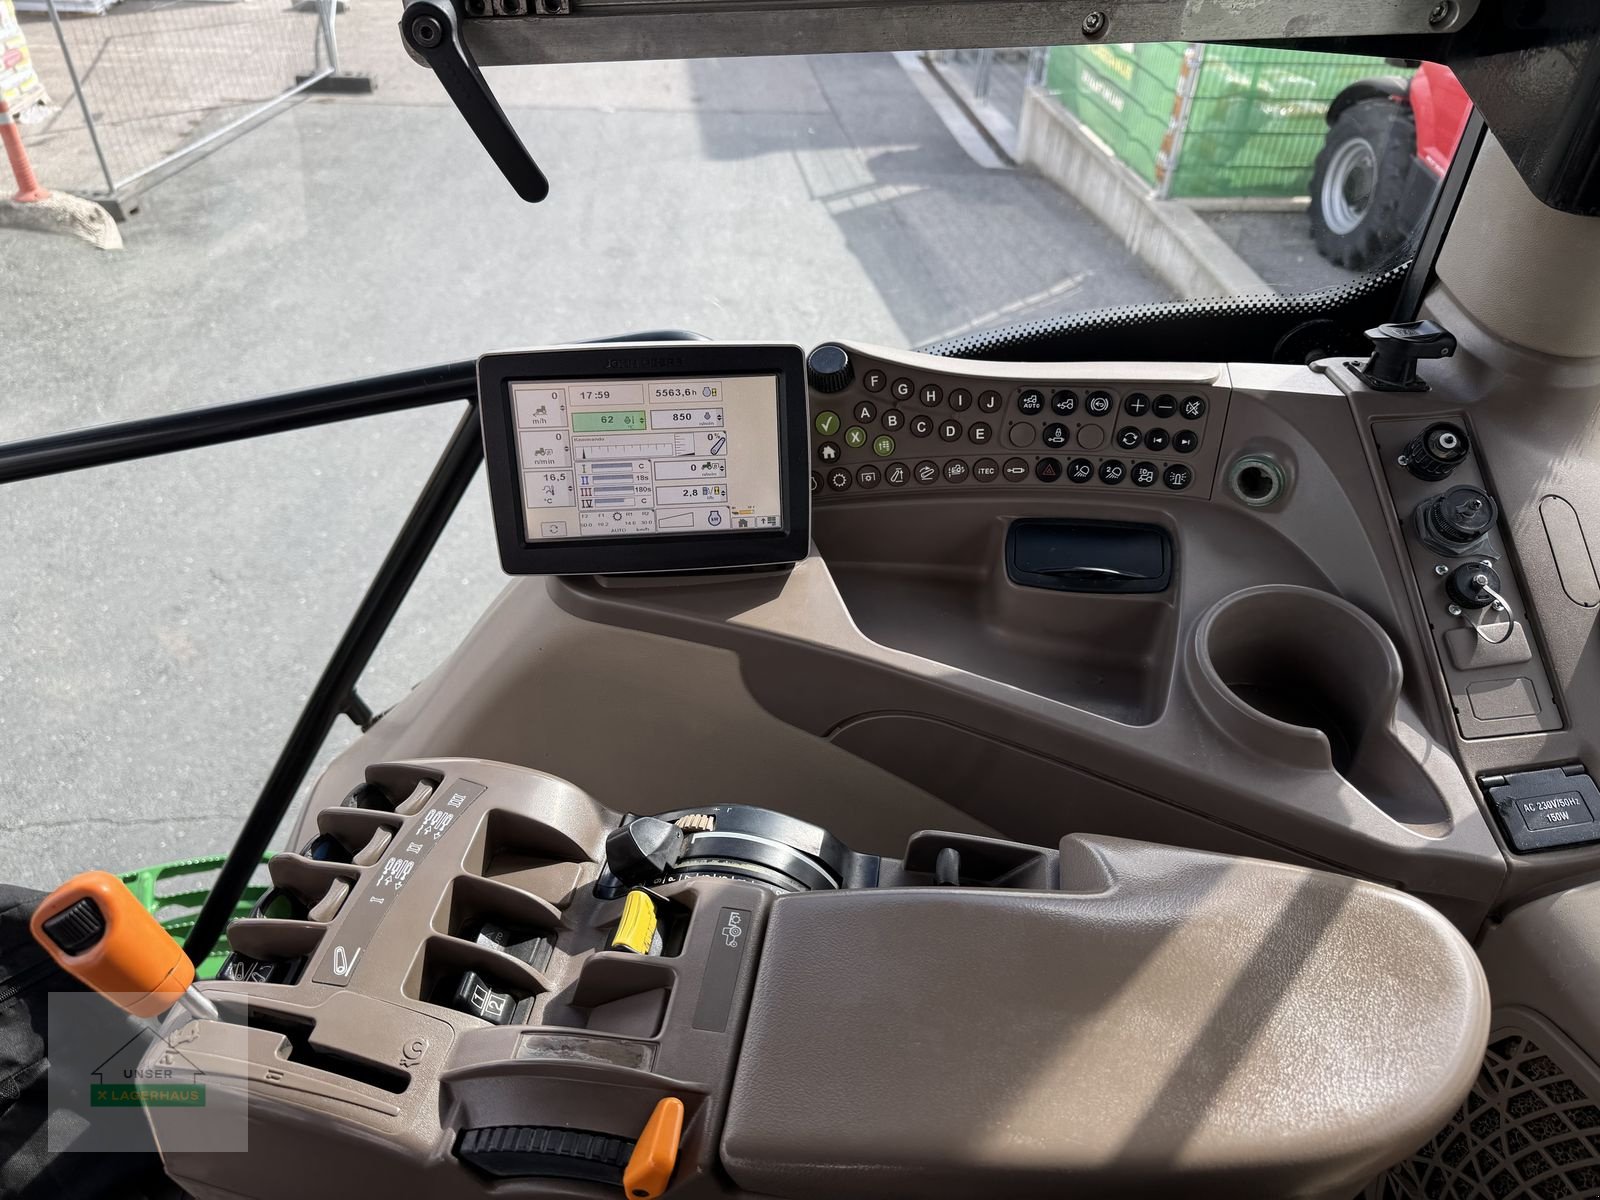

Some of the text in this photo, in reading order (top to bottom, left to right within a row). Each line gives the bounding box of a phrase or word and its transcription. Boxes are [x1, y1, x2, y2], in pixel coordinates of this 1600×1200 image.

[870, 375, 879, 387] F
[898, 383, 908, 395] G
[551, 392, 558, 400] 0
[580, 391, 610, 400] 17:59
[926, 391, 936, 402] H
[958, 395, 963, 406] I
[987, 397, 995, 408] J
[672, 413, 692, 422] 850
[860, 407, 871, 419] A
[601, 416, 614, 424] 62
[888, 415, 898, 427] B
[916, 422, 927, 433] C
[946, 426, 956, 437] D
[555, 433, 562, 441] 0
[976, 428, 985, 440] E
[1523, 797, 1580, 813] AC 230V/50Hz
[1546, 811, 1569, 823] 150W
